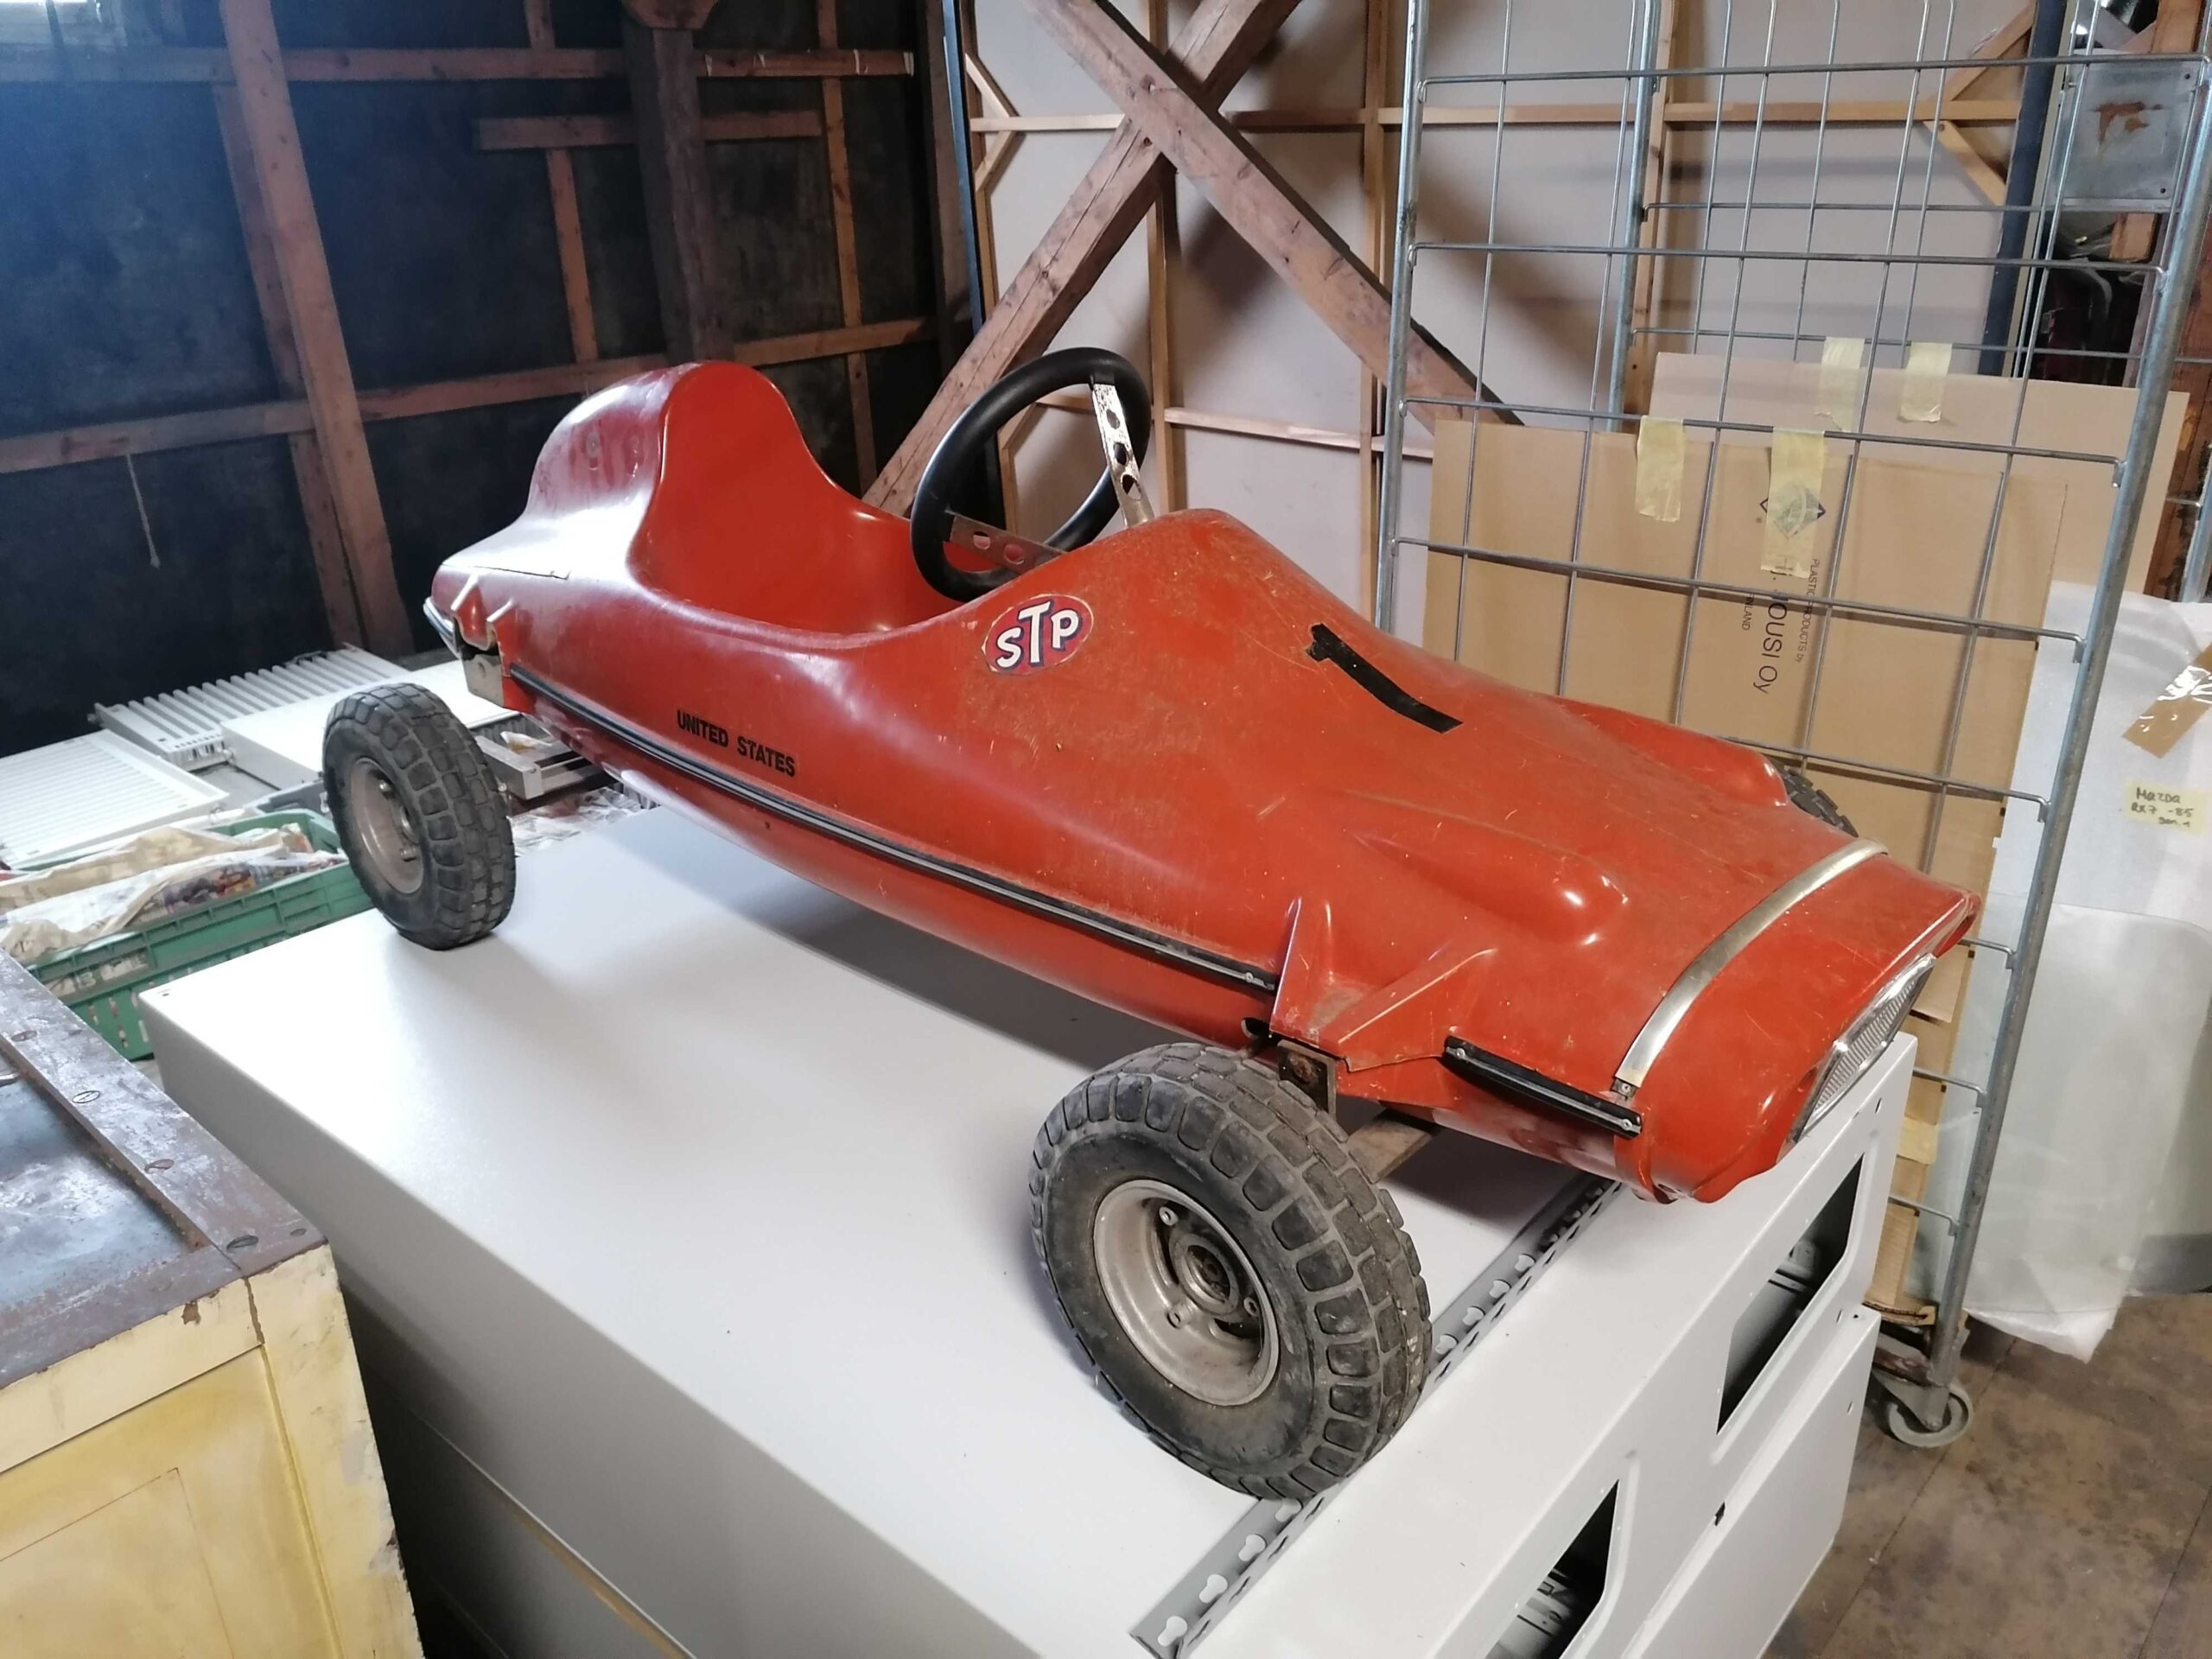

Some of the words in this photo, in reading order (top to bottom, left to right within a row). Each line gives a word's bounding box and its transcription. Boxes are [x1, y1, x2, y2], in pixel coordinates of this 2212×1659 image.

[1805, 558, 1820, 596] PLASTIC
[995, 600, 1080, 669] STP
[1753, 665, 1778, 694] Oy
[677, 709, 729, 747] UNITED
[737, 735, 796, 778] STATES
